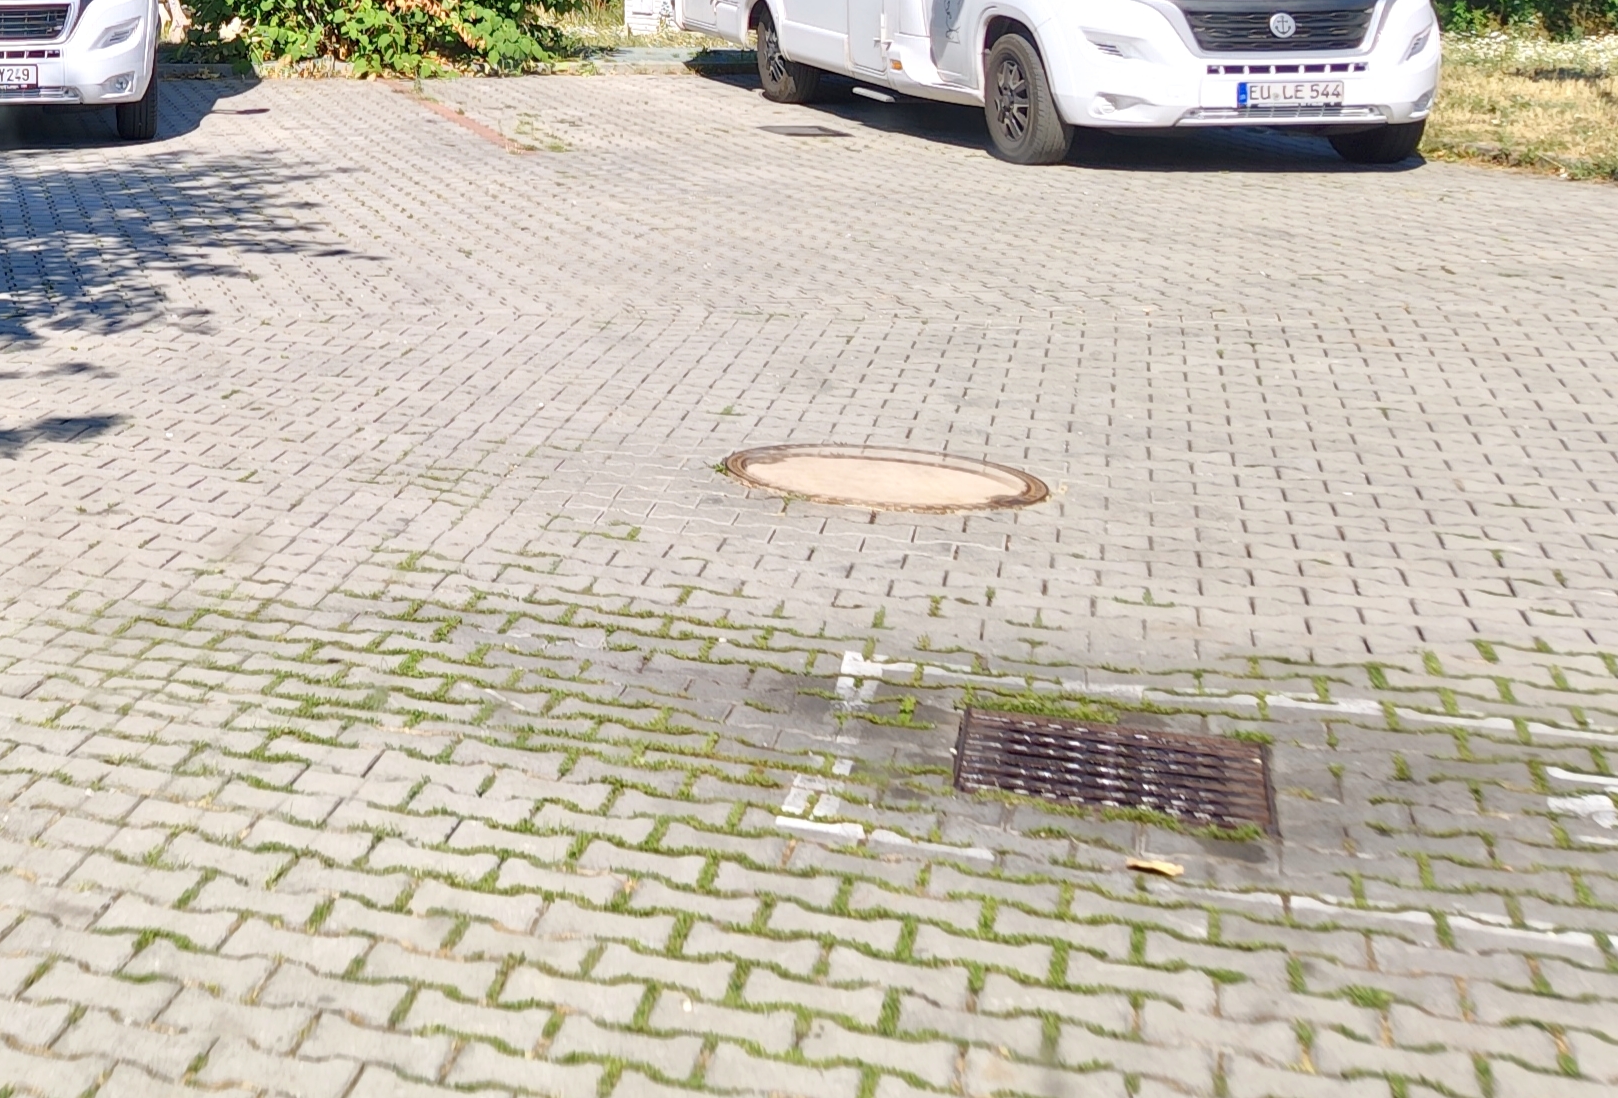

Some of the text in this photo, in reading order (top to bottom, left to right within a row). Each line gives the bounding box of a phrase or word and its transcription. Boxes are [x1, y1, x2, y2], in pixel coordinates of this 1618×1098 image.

[1249, 83, 1341, 100] EU LE 544
